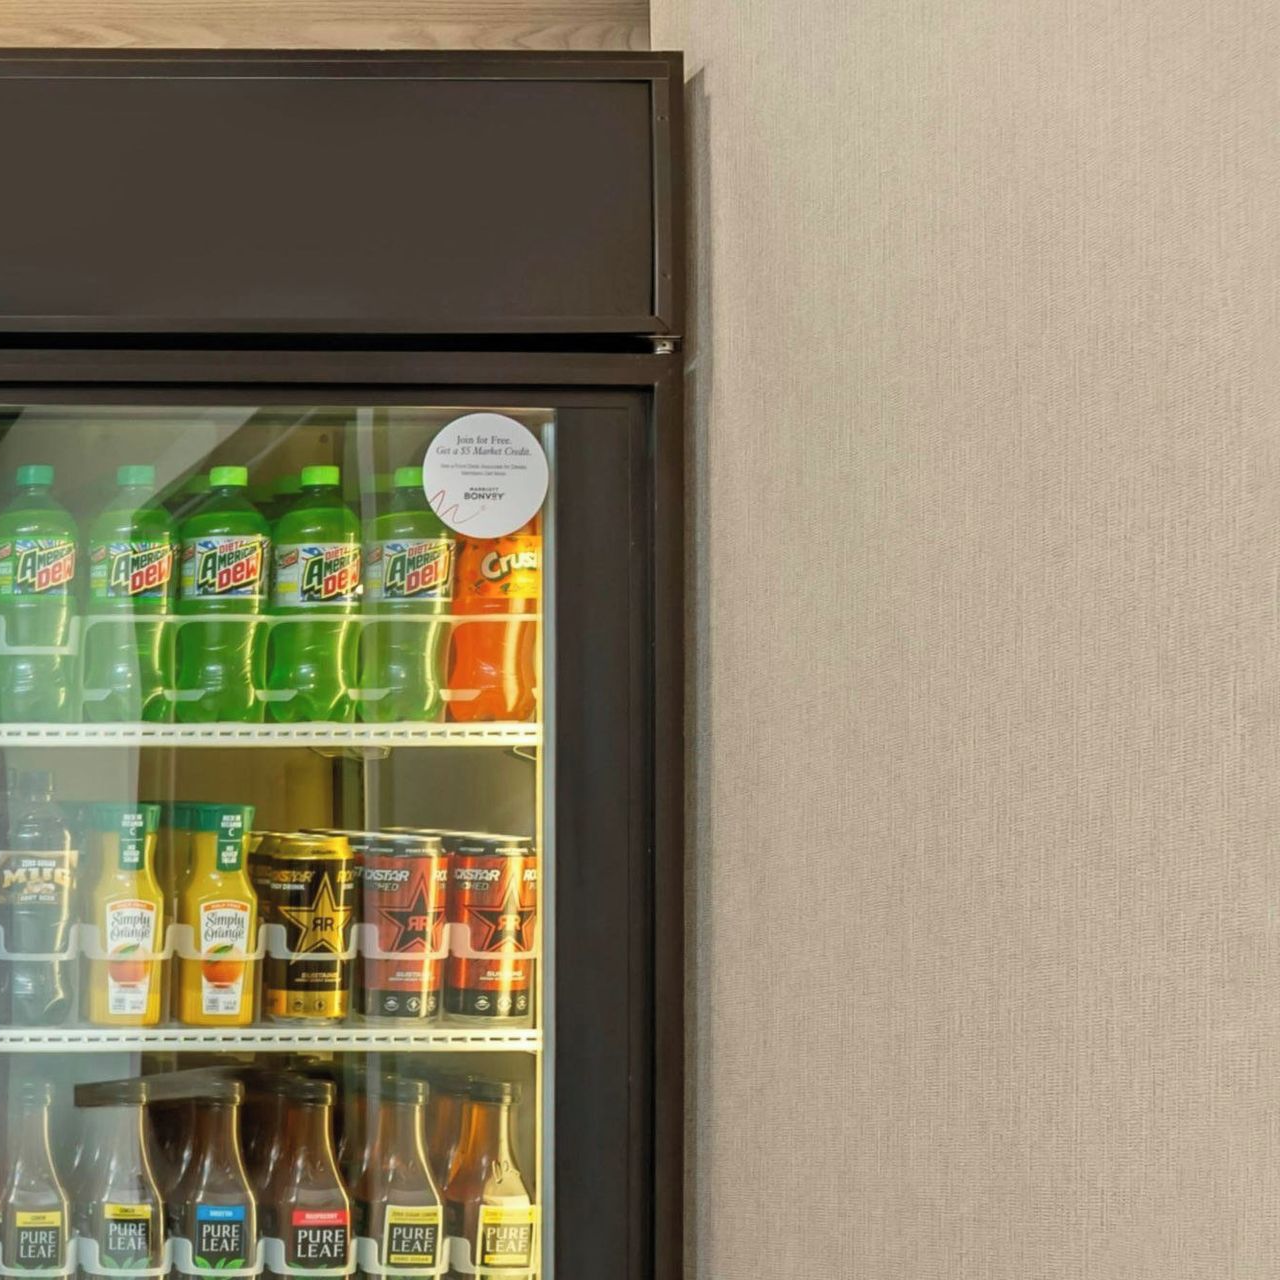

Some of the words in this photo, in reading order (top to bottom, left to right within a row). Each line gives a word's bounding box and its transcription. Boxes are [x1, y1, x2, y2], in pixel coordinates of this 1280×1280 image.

[457, 435, 474, 445] Join
[476, 436, 488, 445] for
[491, 436, 512, 445] Free.
[436, 446, 451, 455] Get
[473, 447, 502, 455] Market
[504, 447, 531, 456] Credit.
[112, 911, 151, 930] Simply
[205, 911, 245, 930] Simply
[111, 927, 150, 942] Orange
[204, 927, 244, 942] Orange
[109, 1223, 146, 1236] PURE
[202, 1224, 240, 1238] PURE
[298, 1229, 345, 1243] PURE
[392, 1227, 434, 1240] PURE
[486, 1227, 528, 1240] PURE
[20, 1231, 56, 1244] PURE
[109, 1237, 144, 1250] LEAF
[20, 1245, 53, 1258] LEAF
[202, 1238, 237, 1252] LEAF
[297, 1243, 342, 1258] LEAF
[392, 1240, 431, 1253] LEAF
